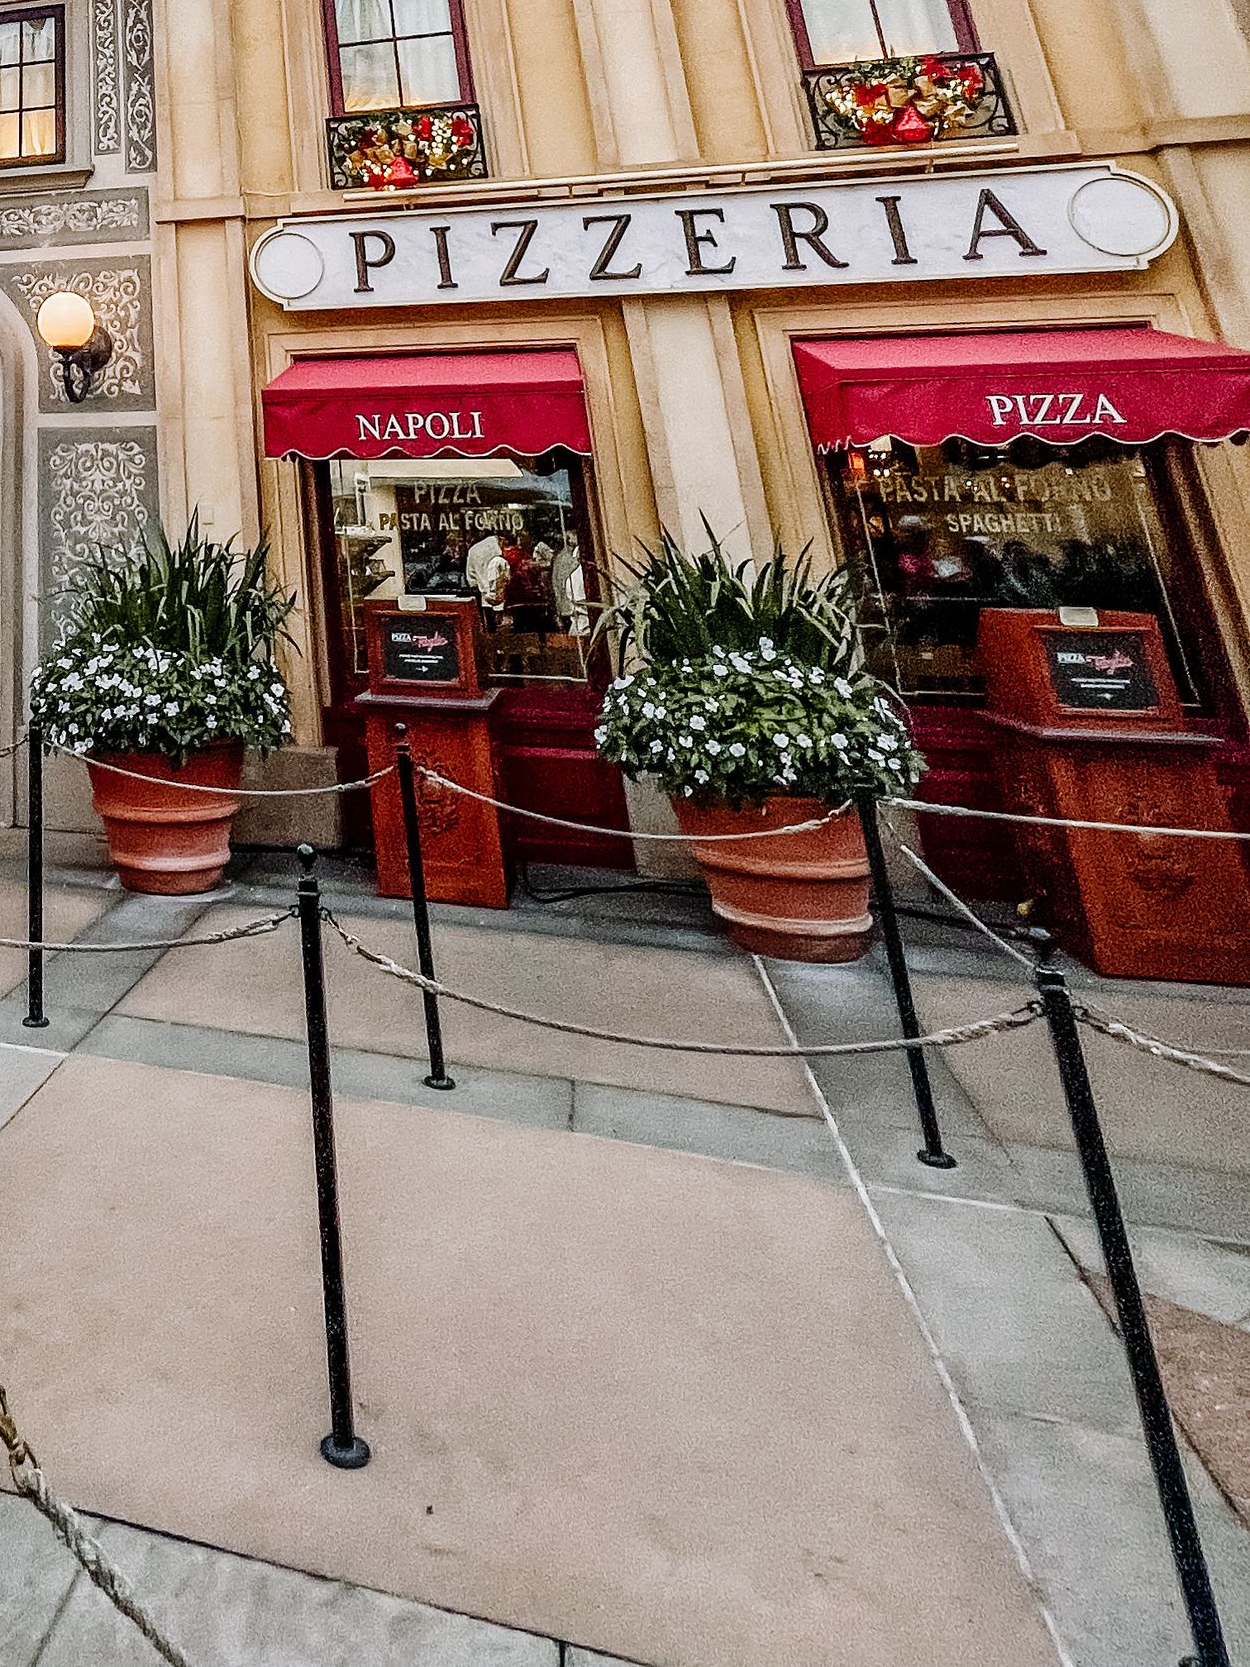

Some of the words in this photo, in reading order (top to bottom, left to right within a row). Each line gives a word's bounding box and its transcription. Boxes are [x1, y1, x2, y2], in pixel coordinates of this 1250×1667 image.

[347, 188, 1048, 293] PIZZERIA
[985, 393, 1127, 426] PIZZA
[355, 411, 486, 441] NAPOLI
[413, 479, 483, 504] PIZZA
[879, 475, 961, 503] PASTA
[973, 476, 1006, 502] AL
[378, 512, 432, 532] PASTA
[438, 512, 460, 531] AL
[464, 510, 525, 532] FORNO
[946, 512, 1062, 533] SPAGHETTI
